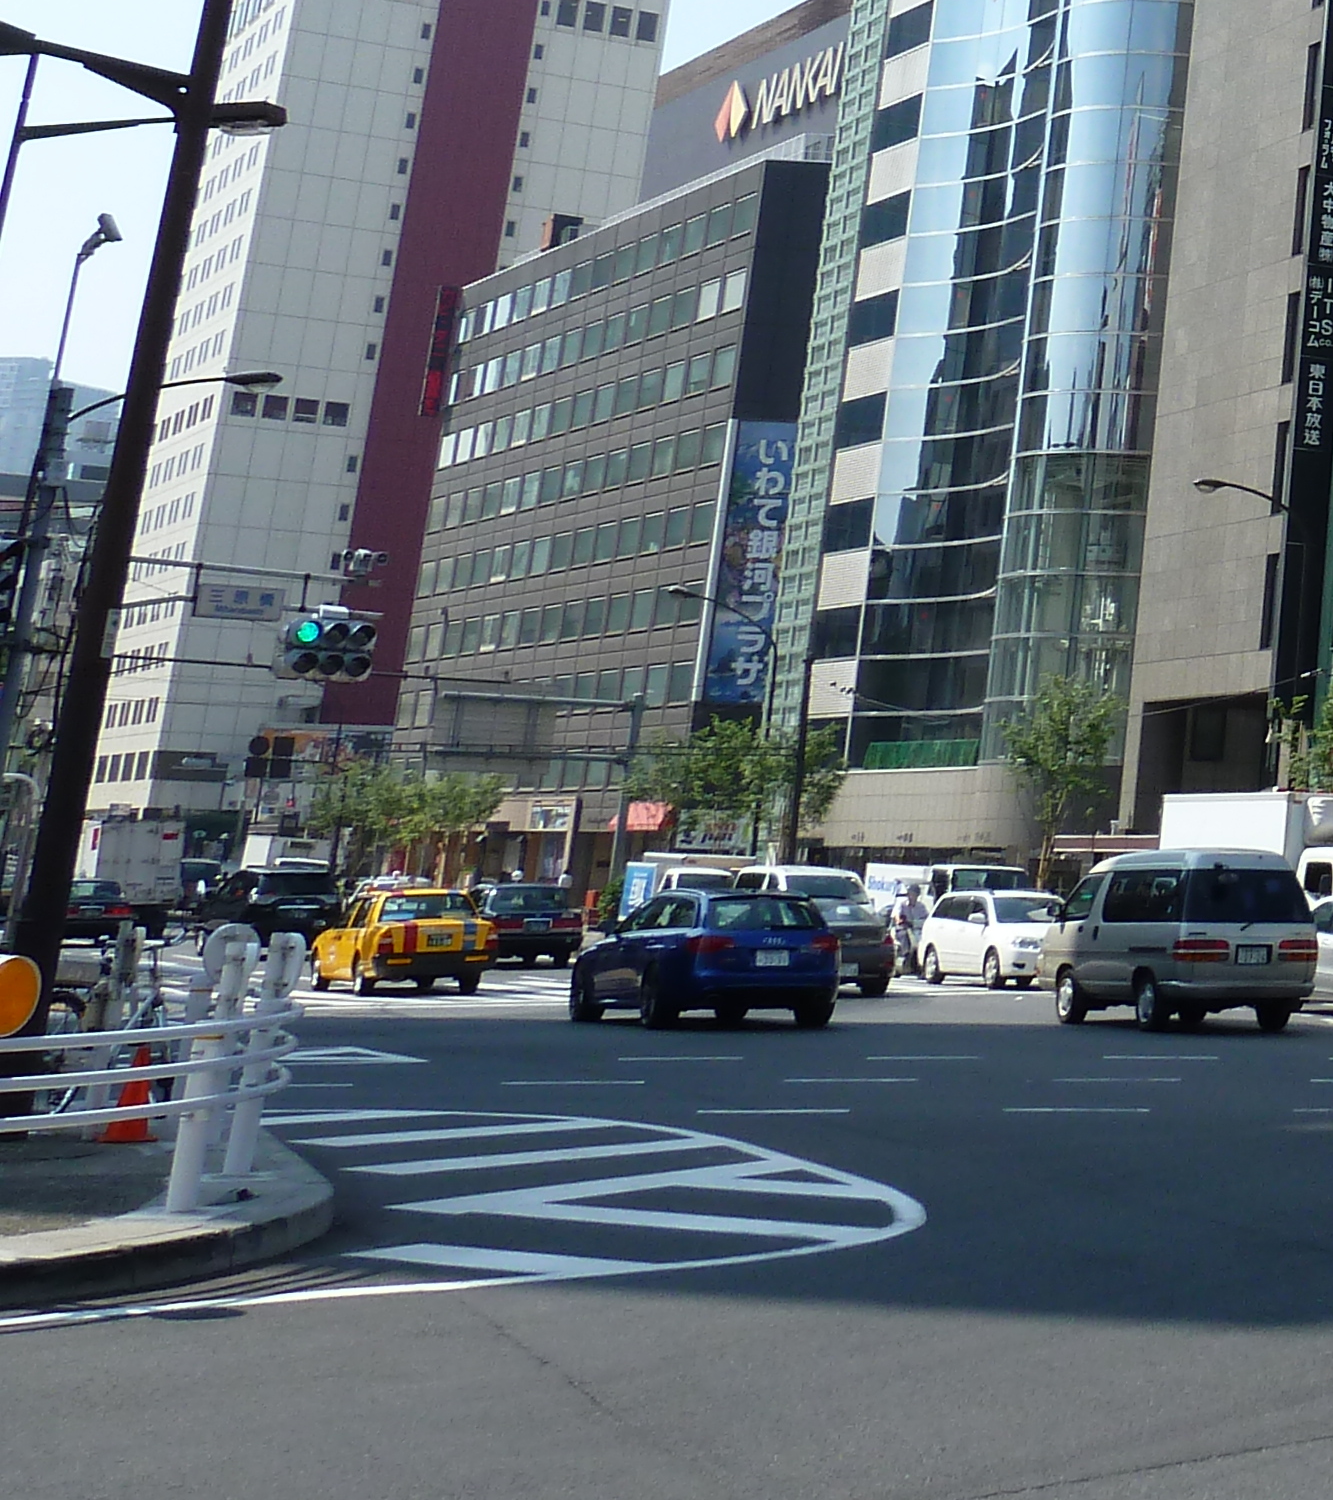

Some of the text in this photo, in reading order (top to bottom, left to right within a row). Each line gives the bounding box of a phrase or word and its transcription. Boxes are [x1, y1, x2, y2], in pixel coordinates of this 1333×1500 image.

[751, 40, 846, 131] NANKAI
[1303, 363, 1326, 446] 東日本放送
[731, 437, 789, 686] いわて銀河プラザ
